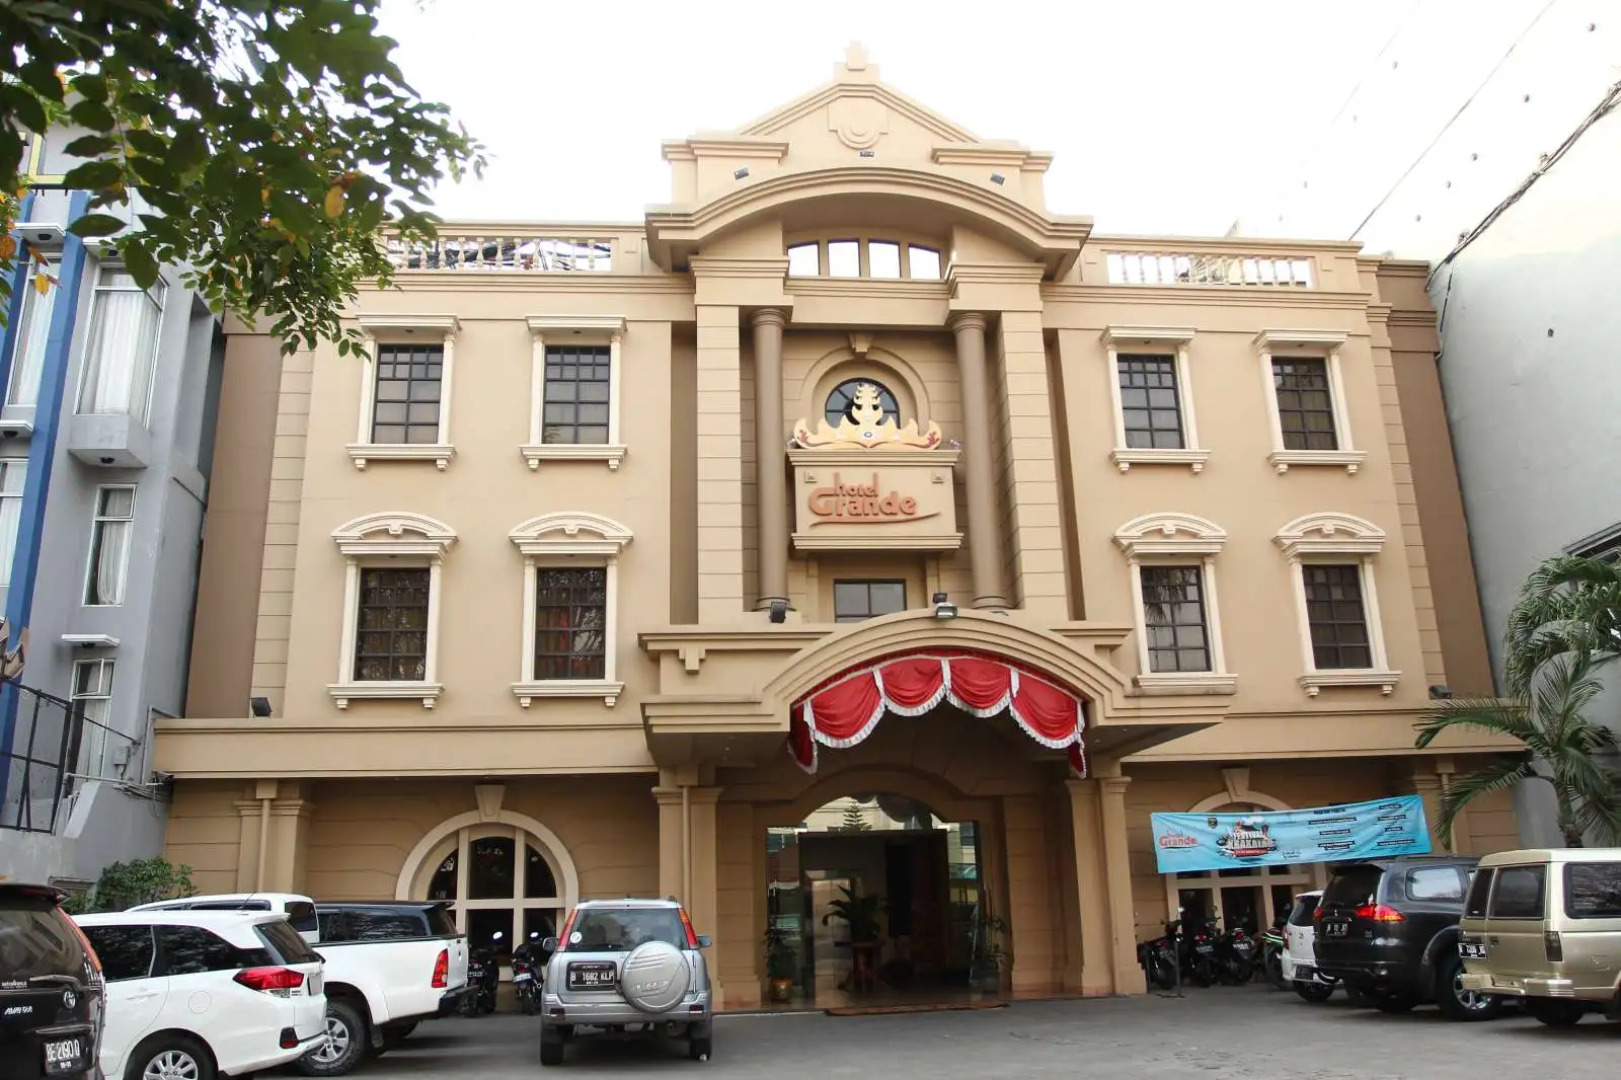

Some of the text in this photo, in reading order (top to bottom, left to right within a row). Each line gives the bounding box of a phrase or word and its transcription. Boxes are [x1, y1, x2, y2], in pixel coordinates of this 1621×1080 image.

[833, 472, 879, 497] hotel
[809, 487, 917, 517] Grande
[1159, 835, 1198, 847] Grande
[570, 972, 577, 982] B
[601, 971, 614, 981] KLP
[47, 1043, 57, 1061] BE
